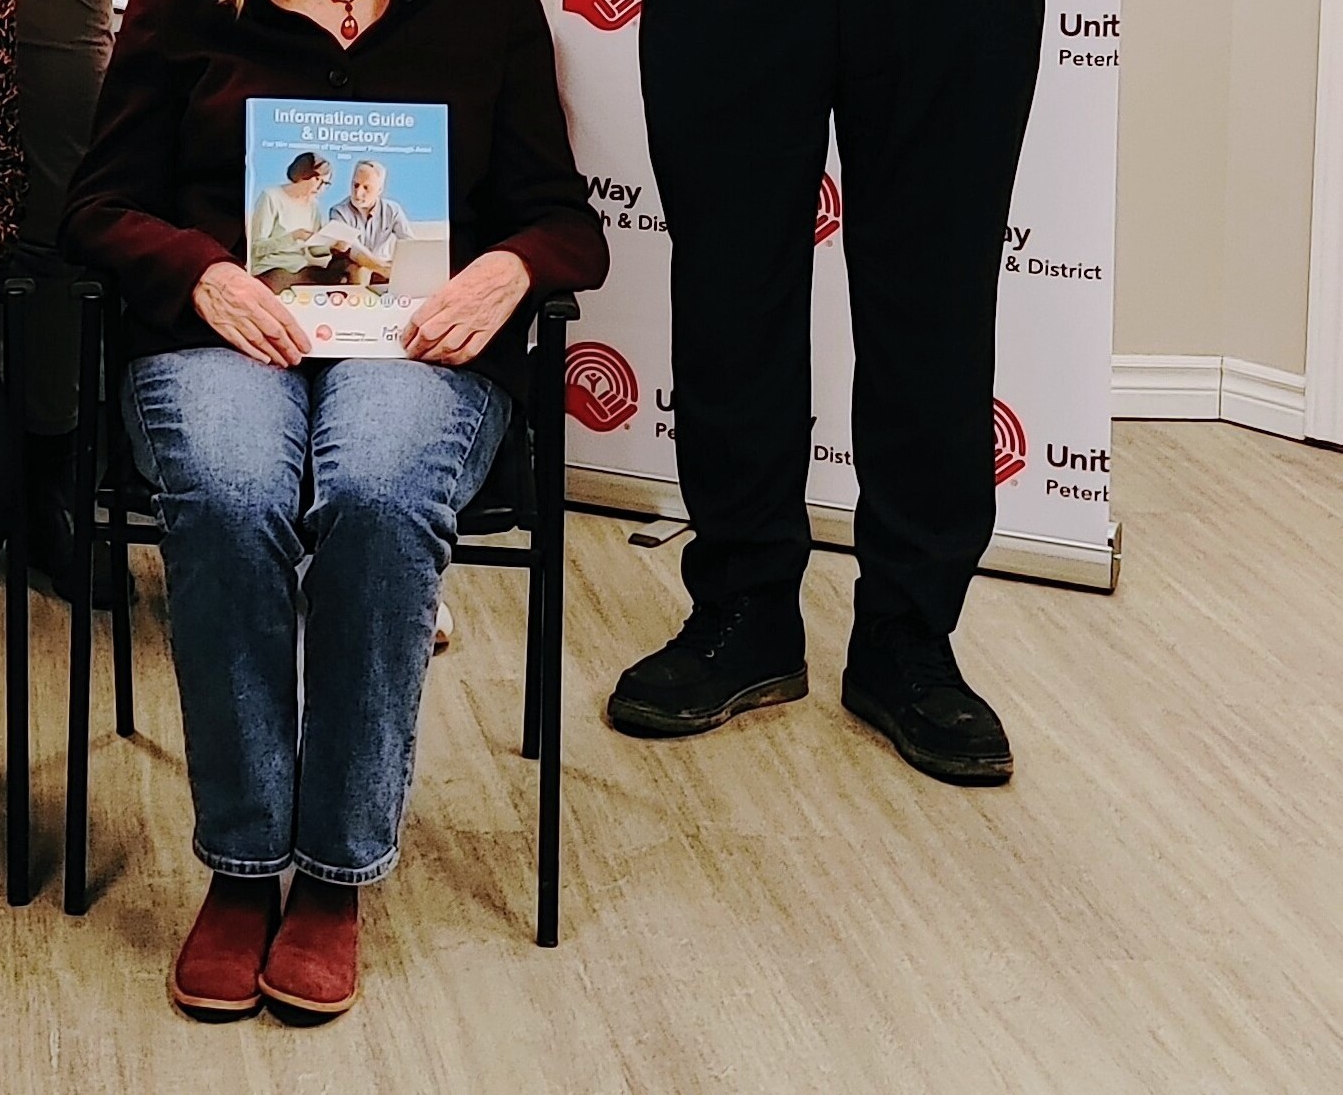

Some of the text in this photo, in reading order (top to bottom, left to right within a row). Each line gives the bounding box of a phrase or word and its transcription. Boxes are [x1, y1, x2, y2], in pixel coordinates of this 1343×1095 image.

[274, 107, 416, 128] Information Guide
[301, 125, 391, 146] & Directory
[586, 176, 642, 209] Way
[617, 212, 632, 229] &
[1005, 255, 1102, 280] & District
[813, 444, 852, 466] Dist
